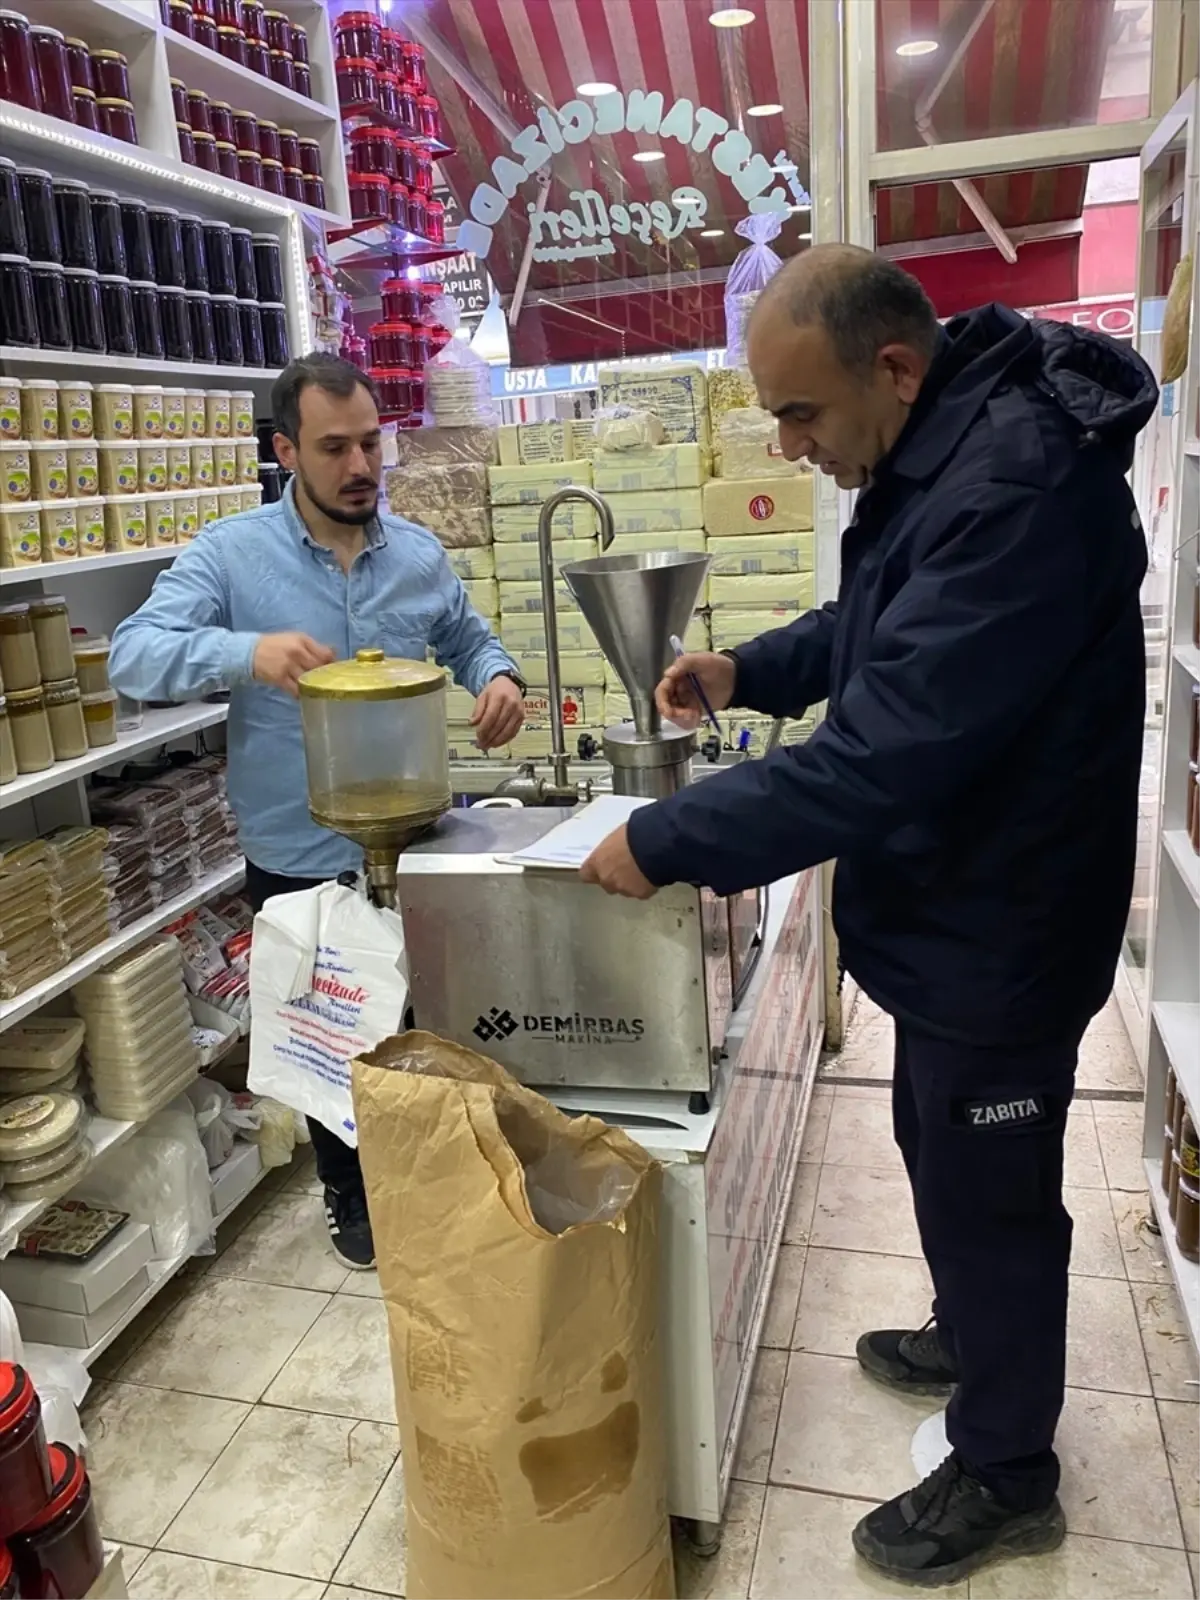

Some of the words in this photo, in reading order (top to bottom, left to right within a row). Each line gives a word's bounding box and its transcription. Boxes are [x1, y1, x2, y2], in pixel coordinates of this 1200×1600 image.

[442, 279, 482, 294] APILIR
[504, 370, 547, 392] USTA
[970, 1098, 1039, 1125] ZABITA
